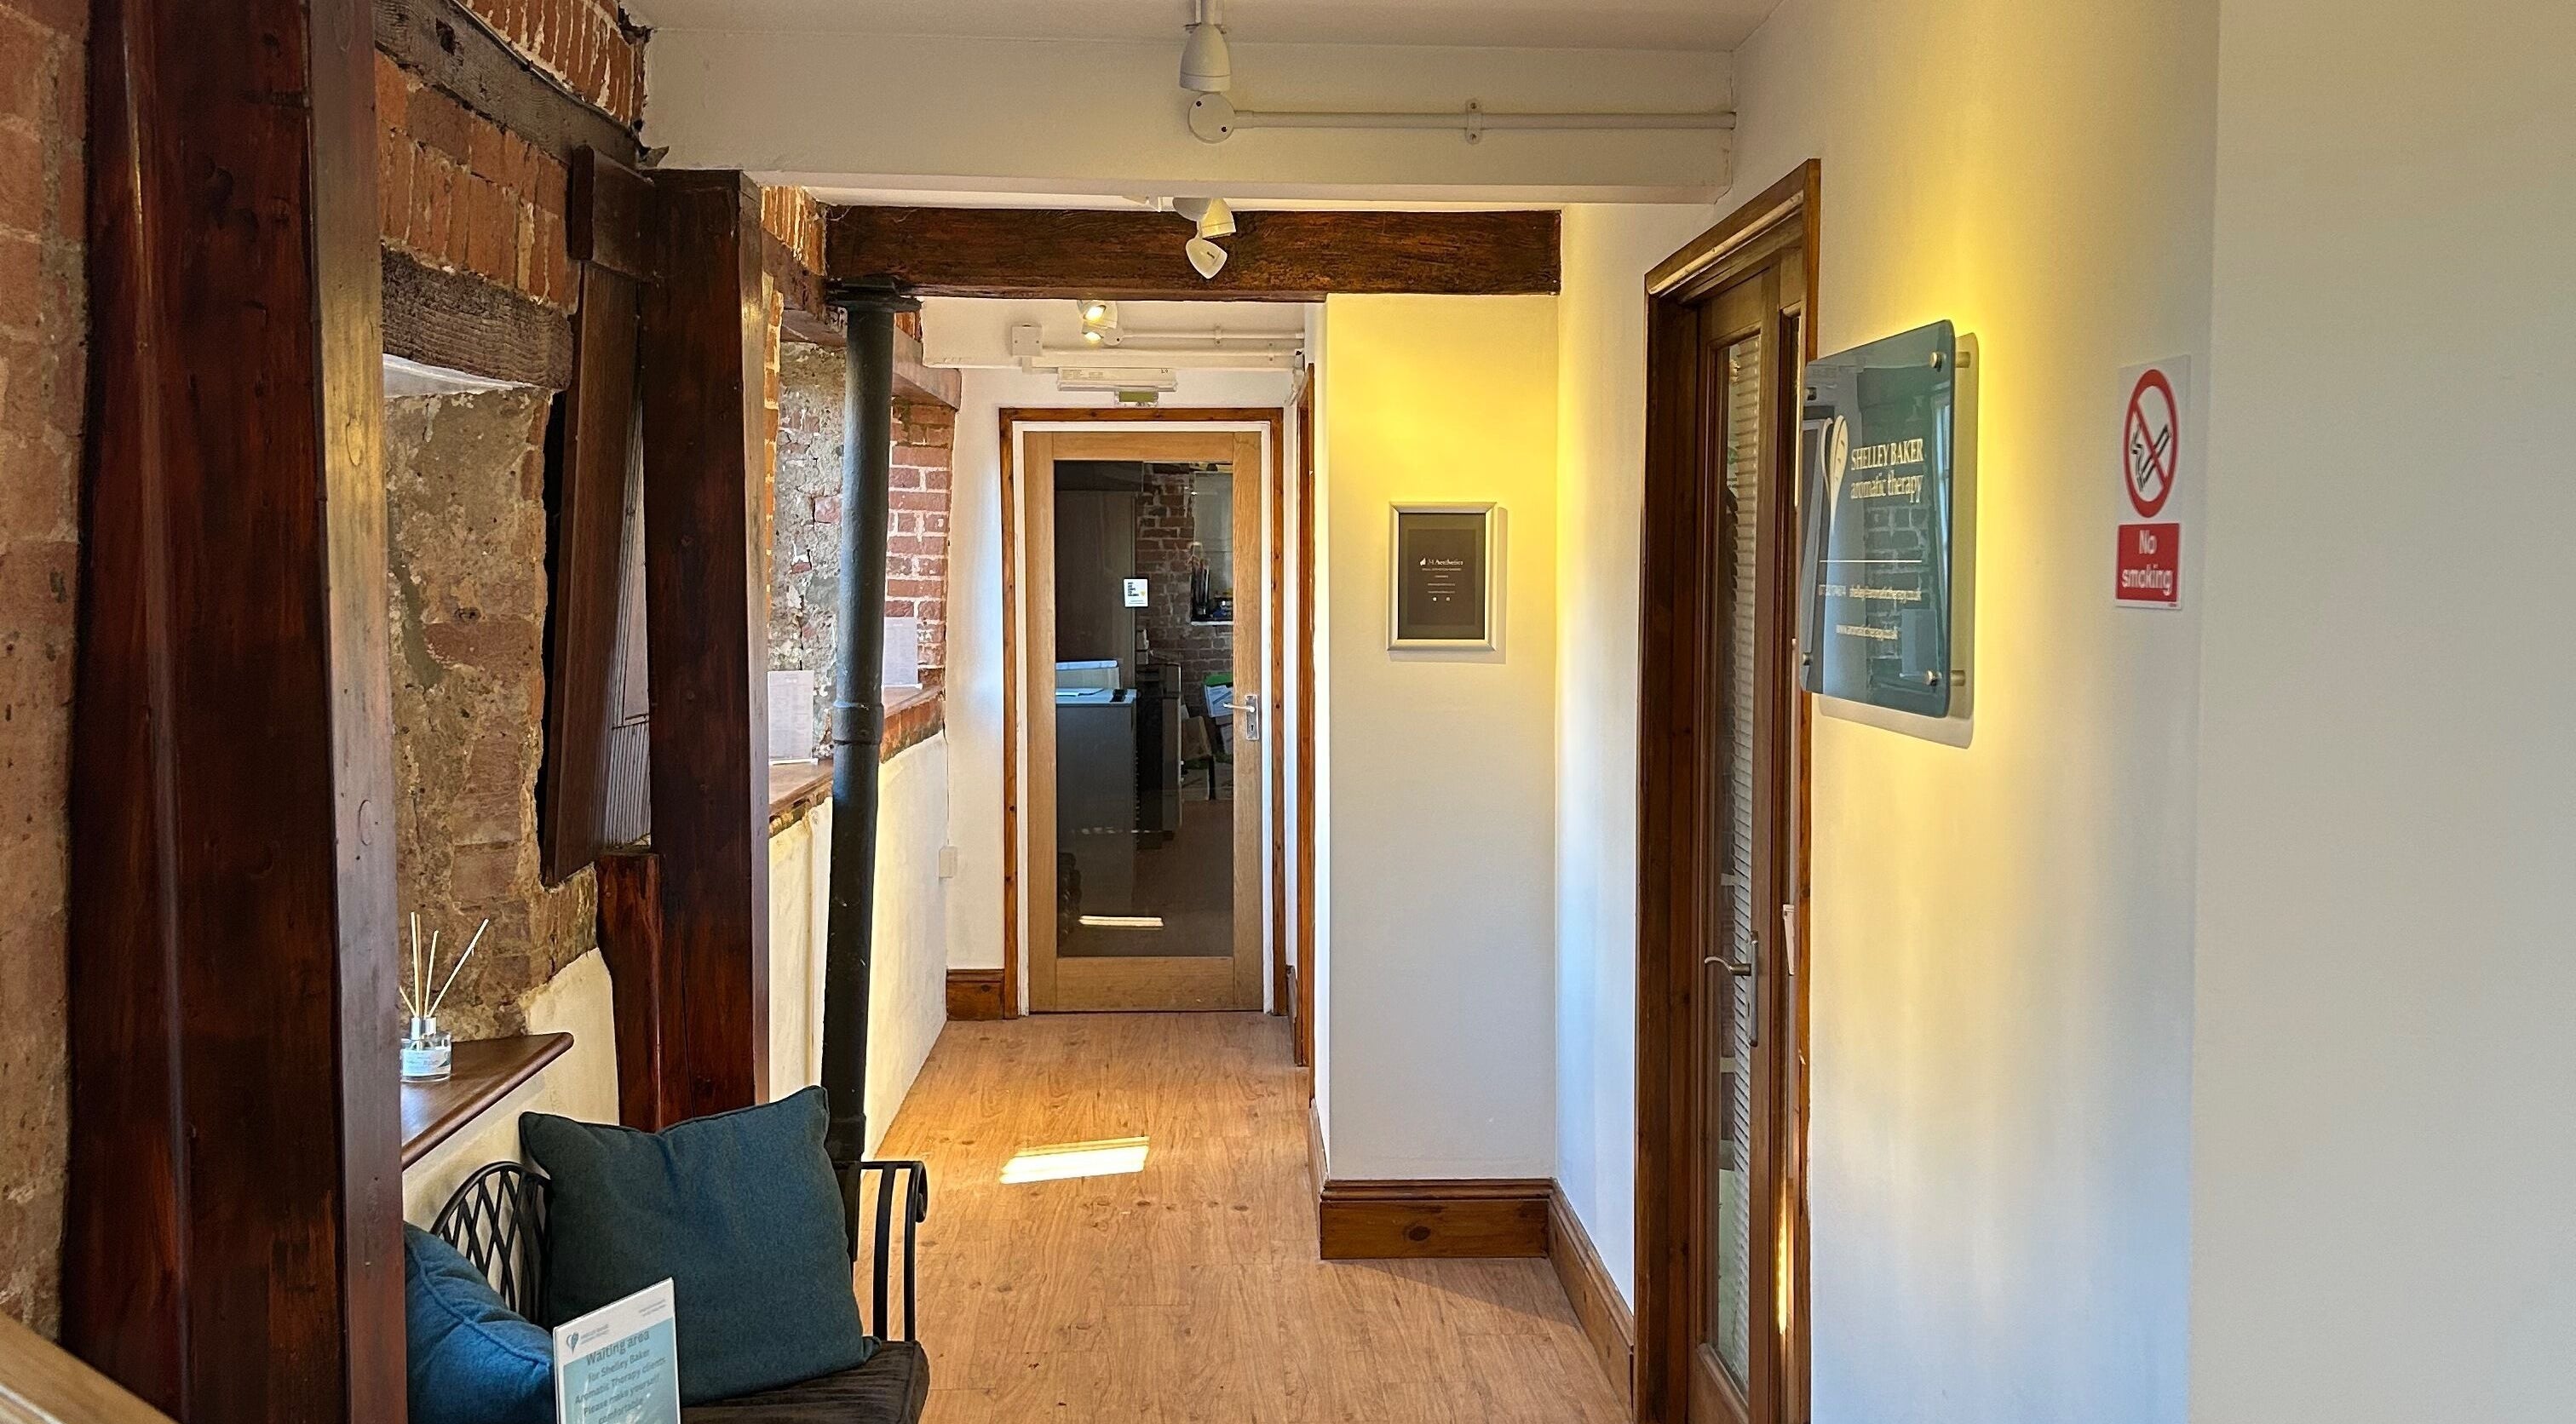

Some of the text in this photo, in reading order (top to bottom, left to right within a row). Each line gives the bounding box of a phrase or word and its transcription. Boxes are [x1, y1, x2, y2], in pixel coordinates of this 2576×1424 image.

[1851, 439, 1923, 470] SHELLEY BAKER
[1850, 469, 1924, 502] aromatic therapy
[2139, 530, 2157, 554] No
[2121, 564, 2173, 595] smoking
[586, 1342, 626, 1366] Waiting
[627, 1331, 650, 1347] area
[601, 1361, 628, 1378] Shelley
[630, 1349, 650, 1364] Baker
[575, 1384, 609, 1404] Aromatic
[612, 1370, 640, 1386] Therapy
